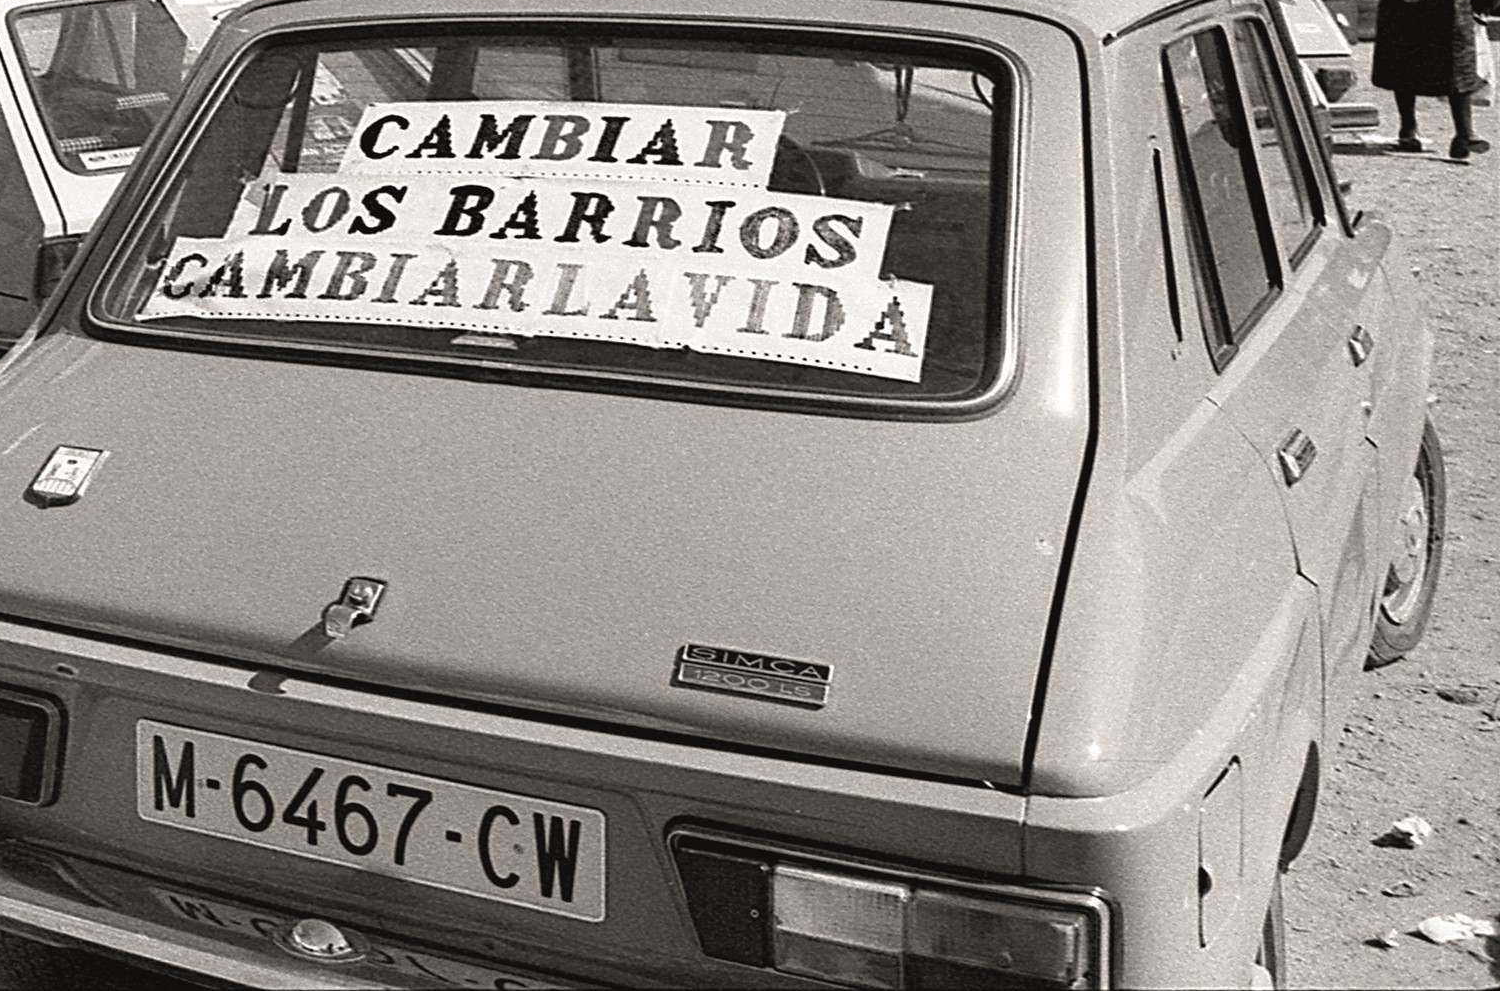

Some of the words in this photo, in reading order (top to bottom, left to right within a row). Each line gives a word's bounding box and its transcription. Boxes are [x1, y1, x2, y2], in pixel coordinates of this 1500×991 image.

[358, 112, 756, 171] CAMBIAR
[247, 183, 409, 238] LOS
[434, 184, 867, 271] BARRIOS
[690, 647, 823, 681] SIMCA
[694, 669, 770, 691] 1200
[778, 682, 812, 698] LS
[151, 734, 582, 904] M-6467-CW
